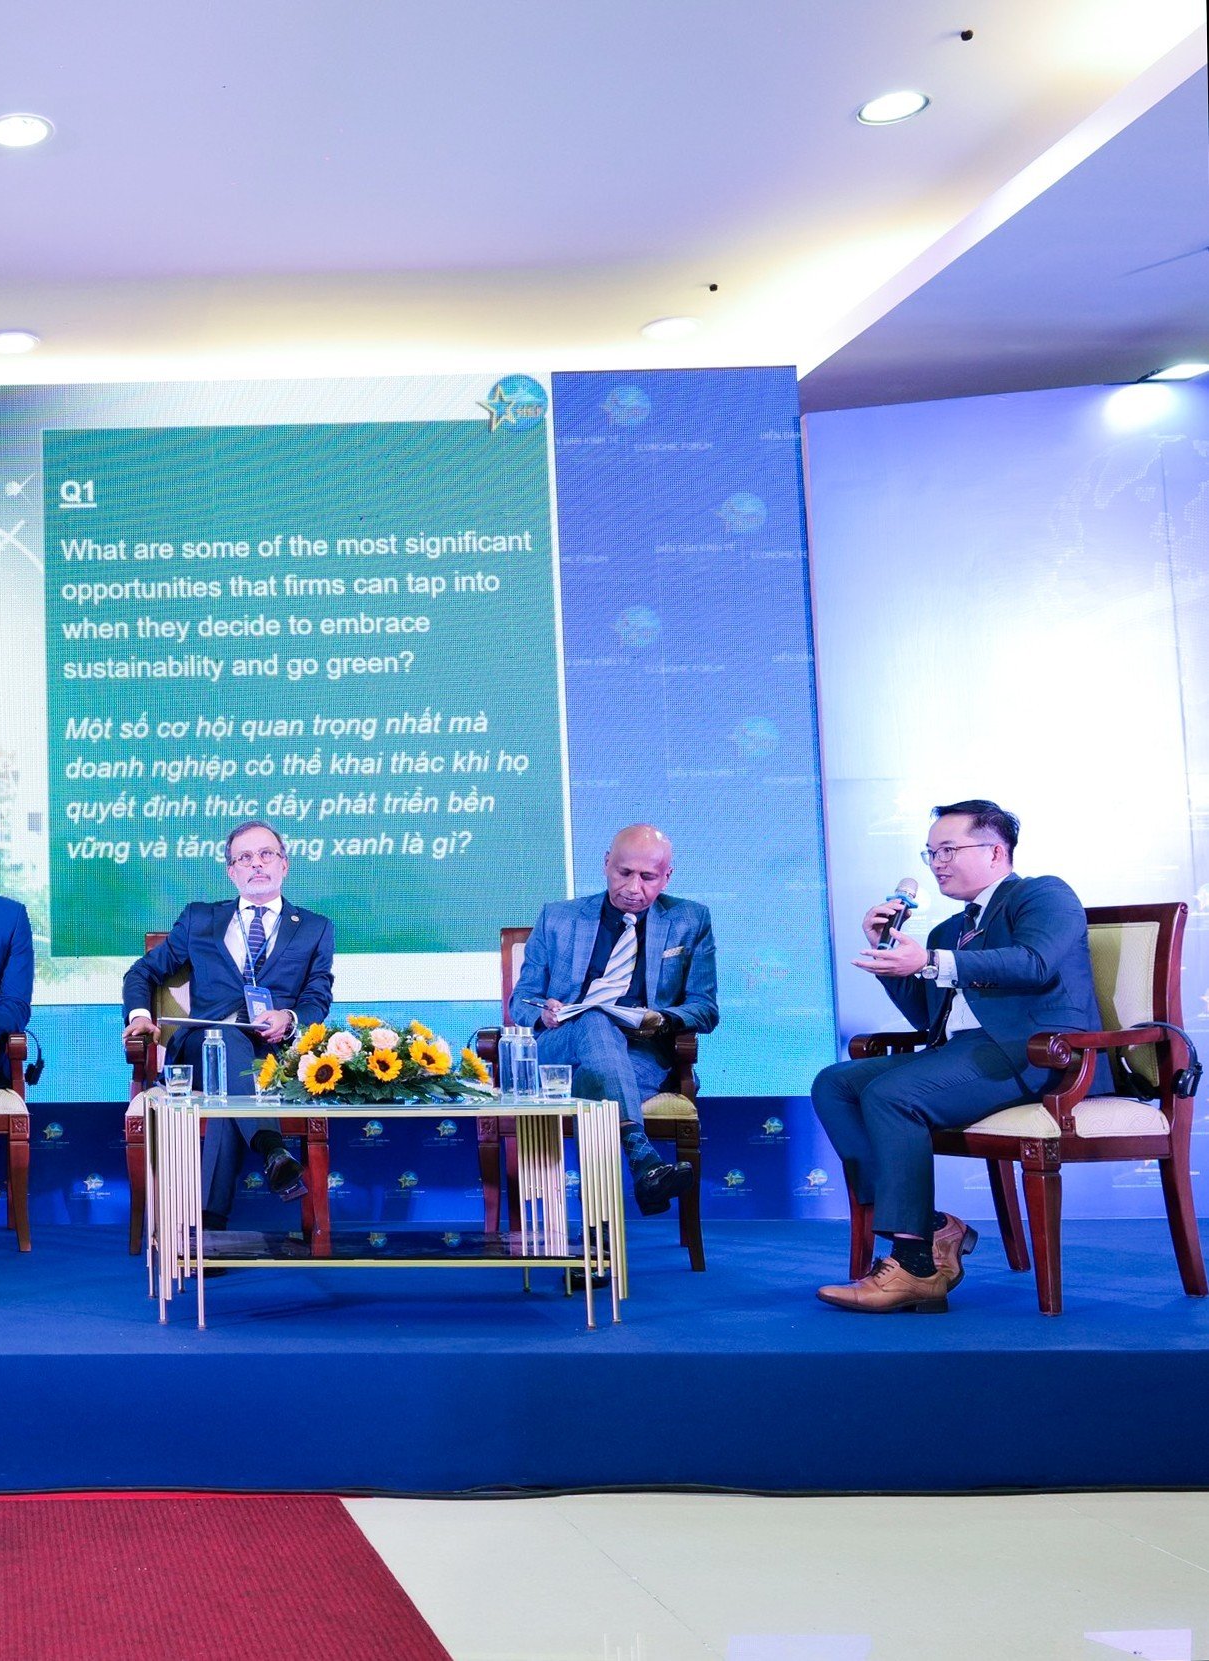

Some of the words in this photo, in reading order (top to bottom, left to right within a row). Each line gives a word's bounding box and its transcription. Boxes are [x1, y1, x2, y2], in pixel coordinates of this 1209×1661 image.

[60, 480, 96, 507] Q1
[61, 539, 127, 561] What
[134, 542, 174, 560] are
[182, 541, 250, 559] some
[257, 535, 283, 557] of
[288, 534, 328, 556] the
[336, 534, 397, 555] most
[405, 530, 532, 559] significant
[62, 578, 222, 605] opportunities
[229, 576, 277, 597] that
[283, 574, 346, 596] firms
[353, 577, 398, 594] can
[406, 573, 446, 598] tap
[454, 572, 500, 592] into
[63, 618, 129, 639] when
[137, 616, 190, 642] they
[198, 614, 281, 637] decide
[288, 615, 313, 635] to
[320, 613, 430, 635] embrace
[64, 655, 224, 683] sustainability
[232, 654, 279, 676] and
[286, 658, 319, 681] go
[326, 651, 415, 680] green?
[65, 717, 113, 742] Một
[120, 712, 150, 739] số
[156, 721, 190, 738] cơ
[196, 715, 234, 741] hội
[241, 719, 304, 742] quan
[313, 714, 378, 741] trọng
[385, 707, 442, 734] nhất
[448, 711, 488, 733] mà
[66, 756, 144, 779] doanh
[152, 756, 237, 783] nghiệp
[244, 754, 275, 776] có
[330, 753, 382, 775] khai
[391, 751, 444, 773] thác
[452, 751, 489, 772] khi
[497, 750, 529, 775] họ
[66, 791, 136, 824] quyết
[143, 795, 197, 820] định
[205, 795, 258, 816] thúc
[319, 792, 377, 820] phát
[139, 836, 168, 860] và
[331, 833, 394, 856] xanh
